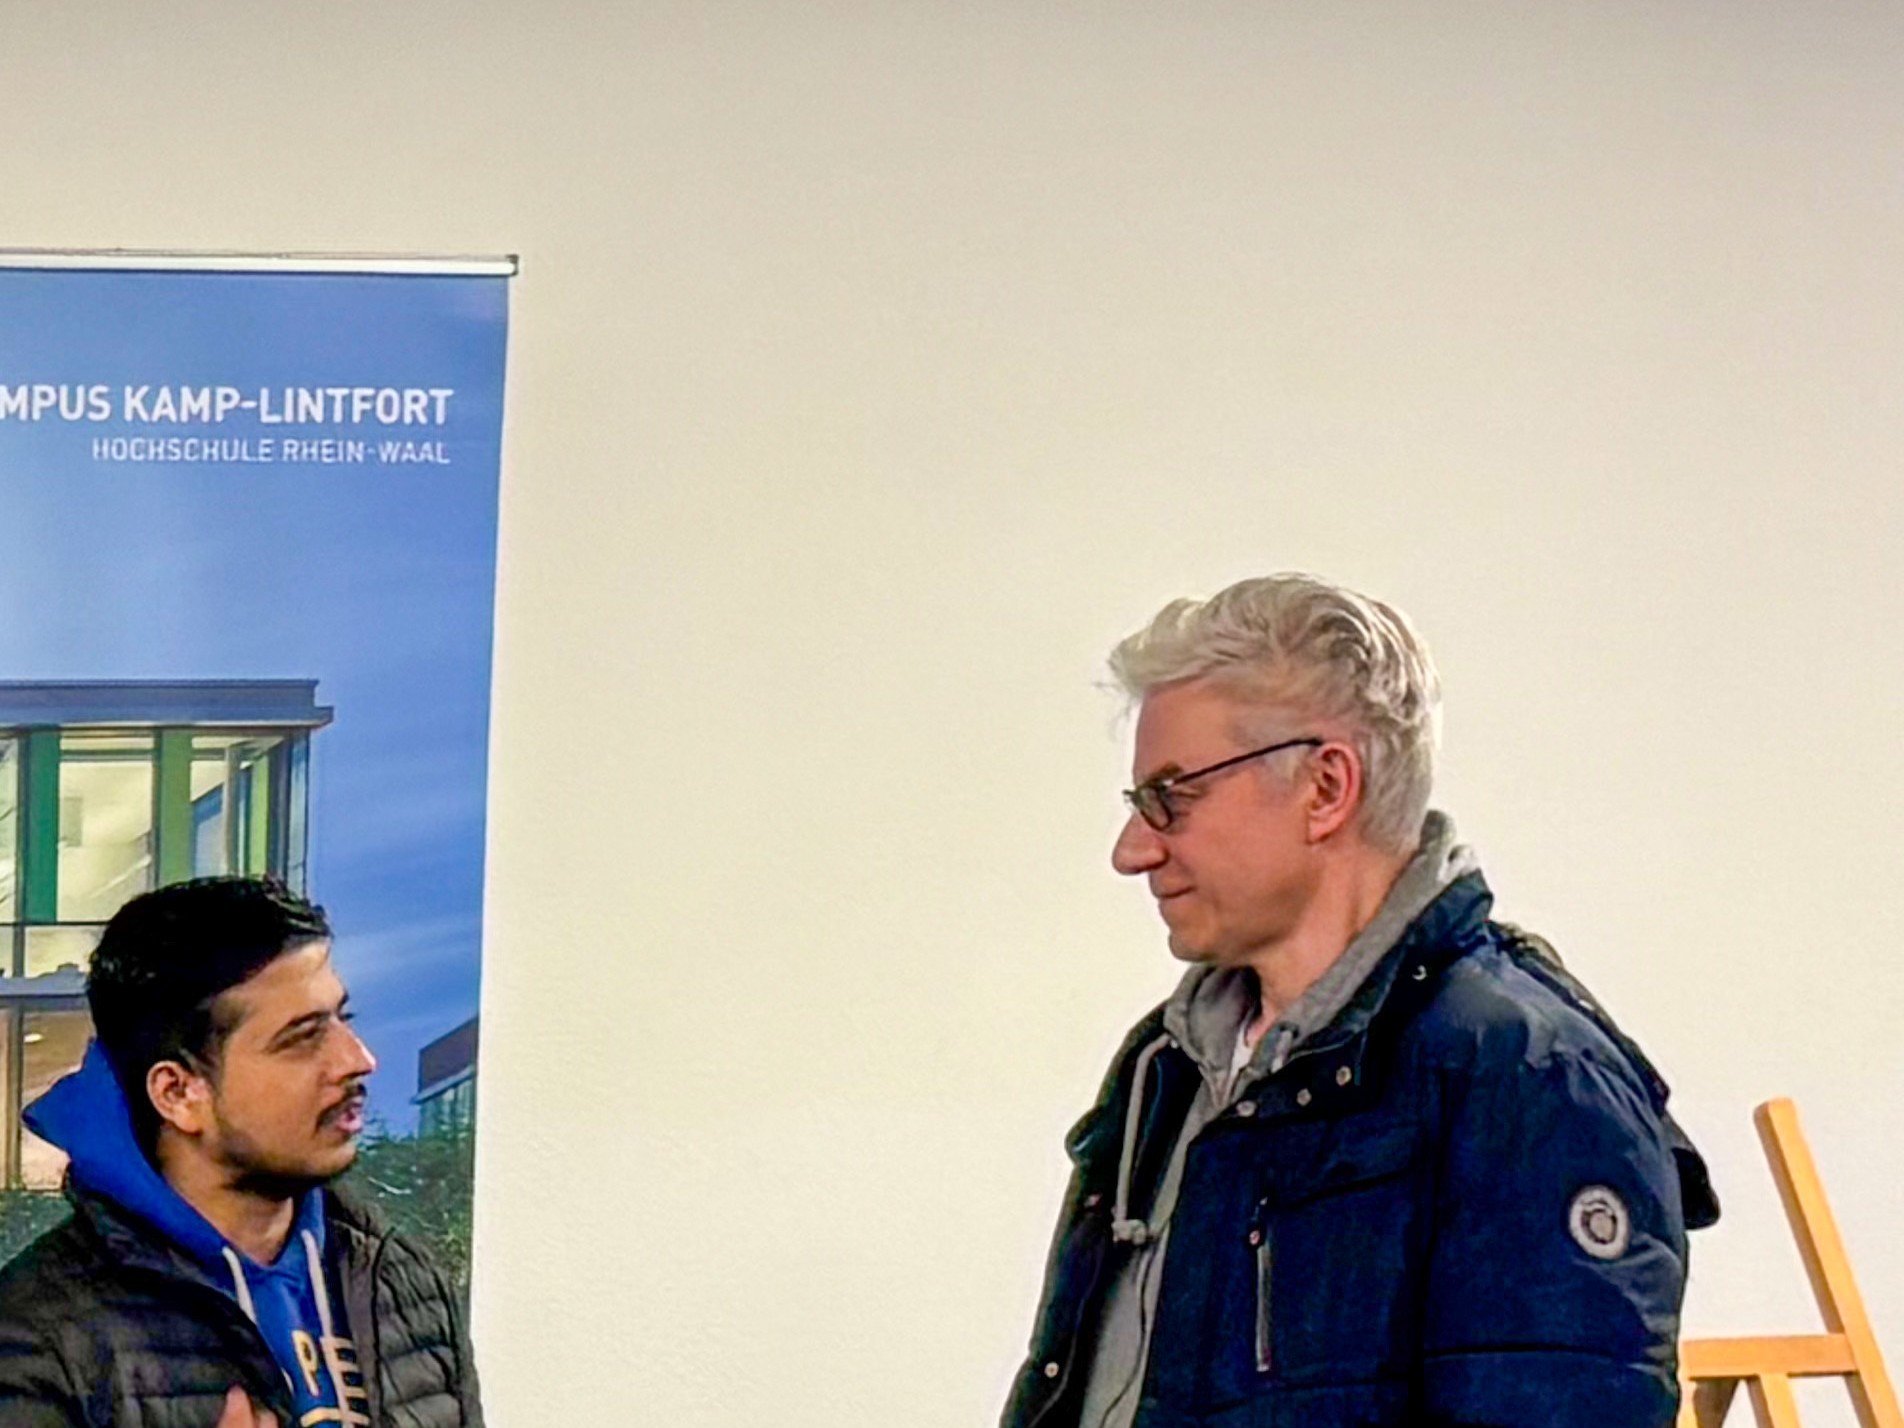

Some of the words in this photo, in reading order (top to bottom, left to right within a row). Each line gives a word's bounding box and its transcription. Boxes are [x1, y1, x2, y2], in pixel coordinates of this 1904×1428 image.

[124, 385, 455, 425] KAMP-LINTFORT
[92, 437, 273, 463] HOCHSCHULE
[282, 439, 451, 465] RHEIN-WAAL
